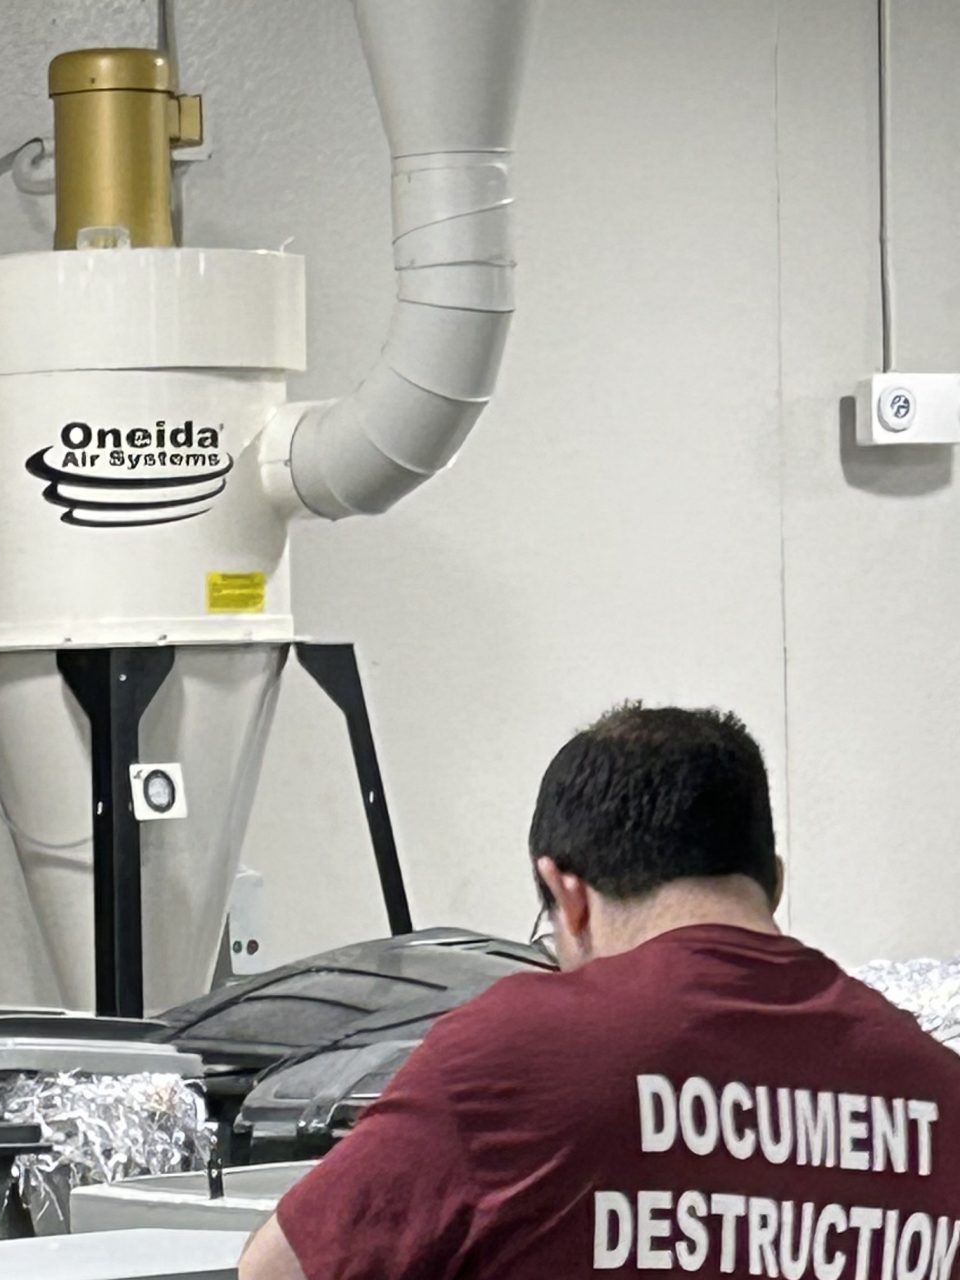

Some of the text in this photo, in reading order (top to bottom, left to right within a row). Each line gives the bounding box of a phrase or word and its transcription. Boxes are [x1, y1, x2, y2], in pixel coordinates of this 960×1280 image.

[61, 420, 219, 449] Oneida
[61, 450, 221, 469] Air Systems
[636, 1073, 939, 1176] DOCUMENT
